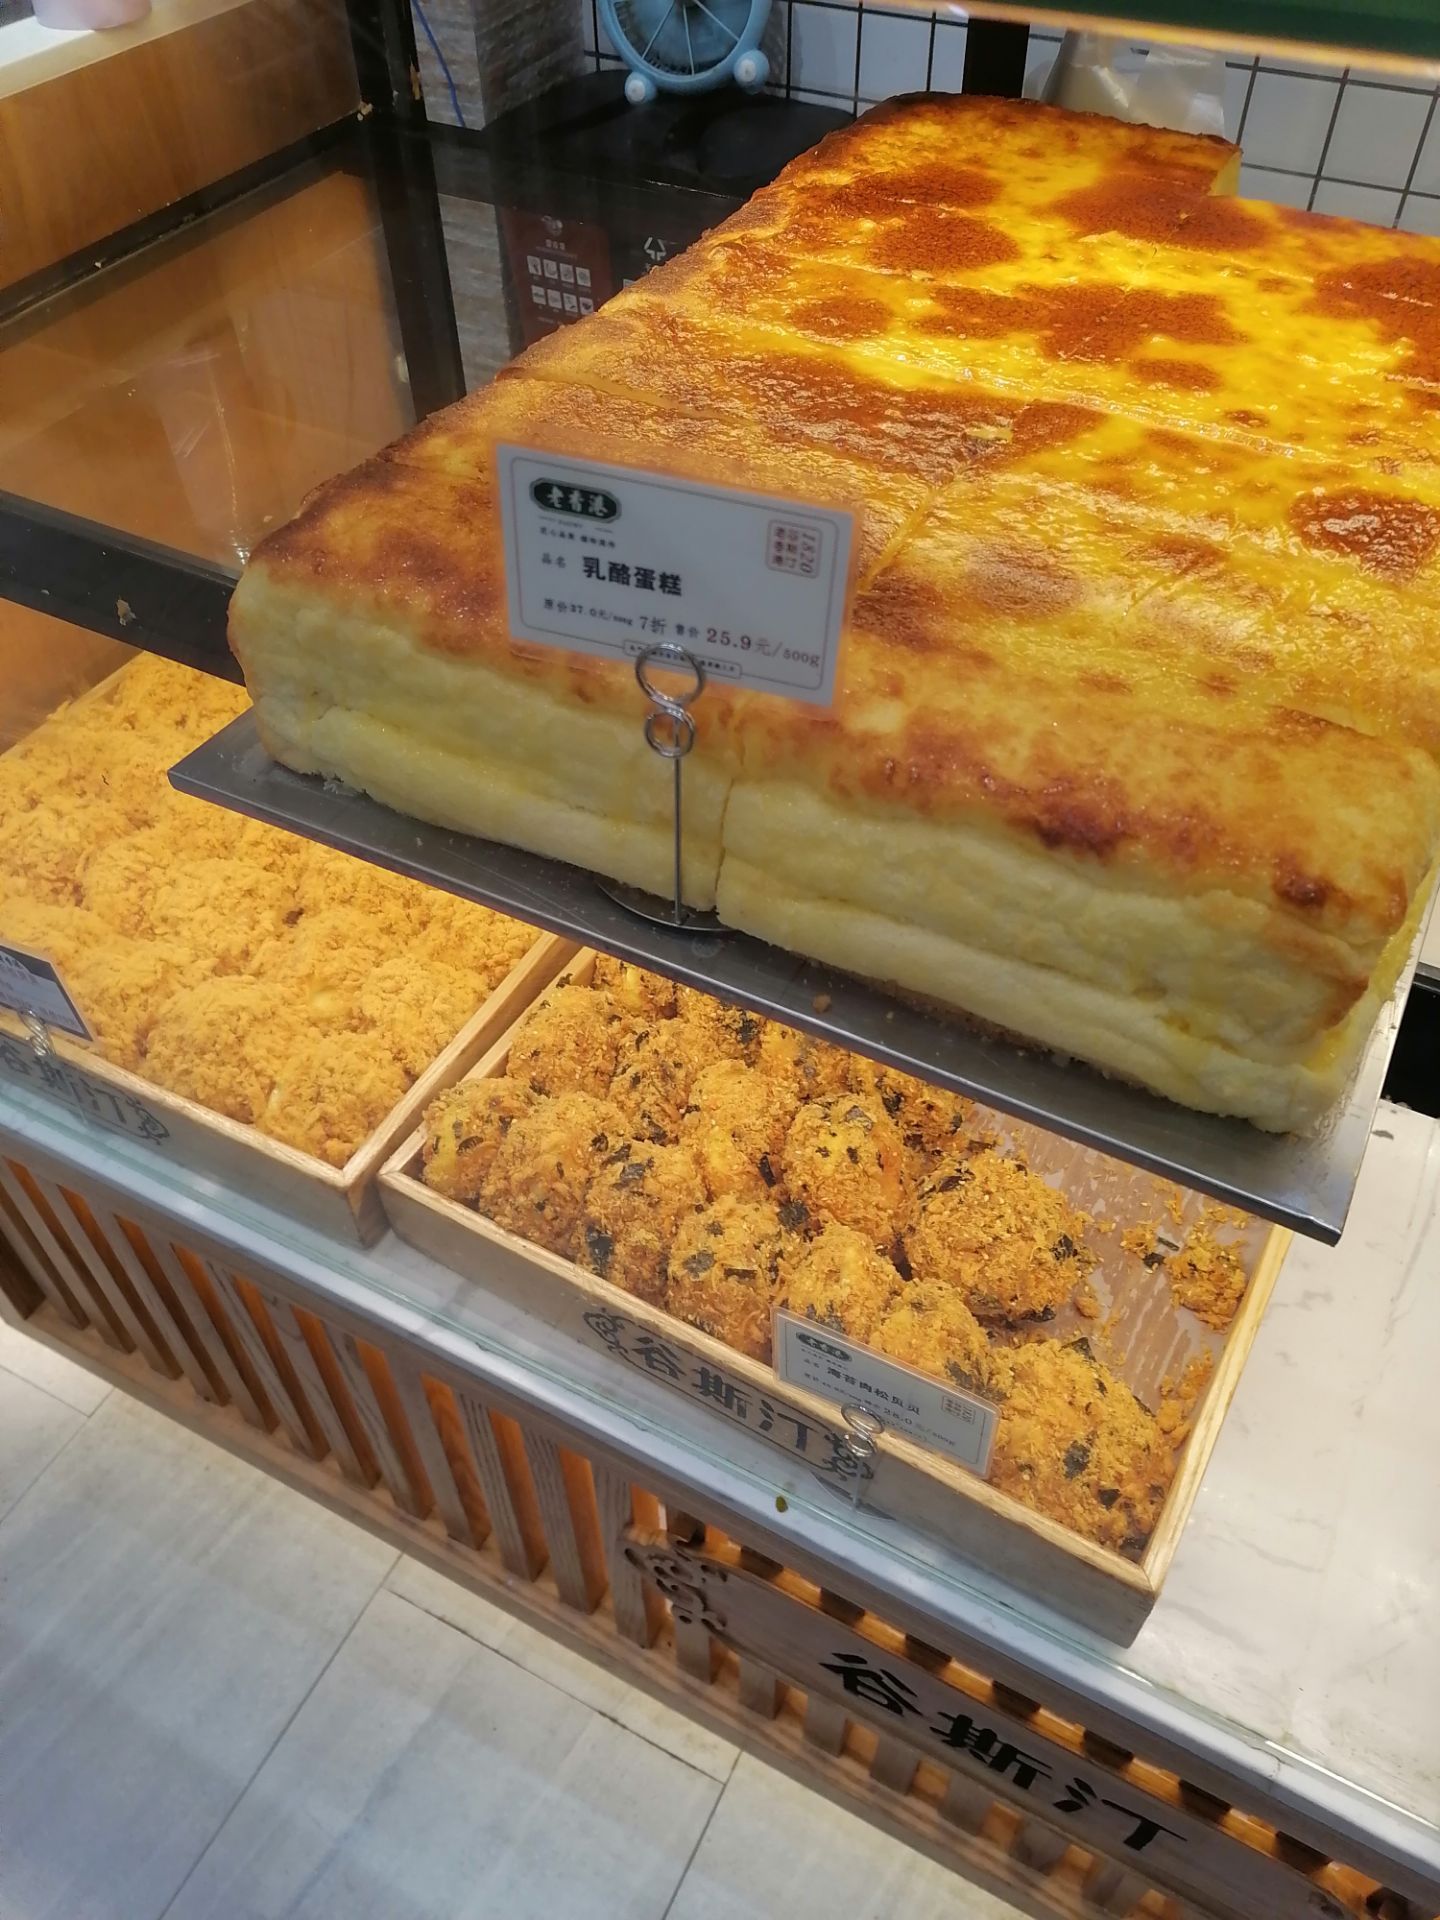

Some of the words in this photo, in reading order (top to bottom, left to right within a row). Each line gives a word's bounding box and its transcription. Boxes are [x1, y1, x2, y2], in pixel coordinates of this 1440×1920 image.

[582, 556, 682, 597] 乳酪蛋糕
[639, 616, 667, 635] 7折
[706, 627, 821, 668] 25.9元/500g
[631, 1336, 819, 1451] 谷斯汀
[819, 1652, 1188, 1851] 谷斯汀
